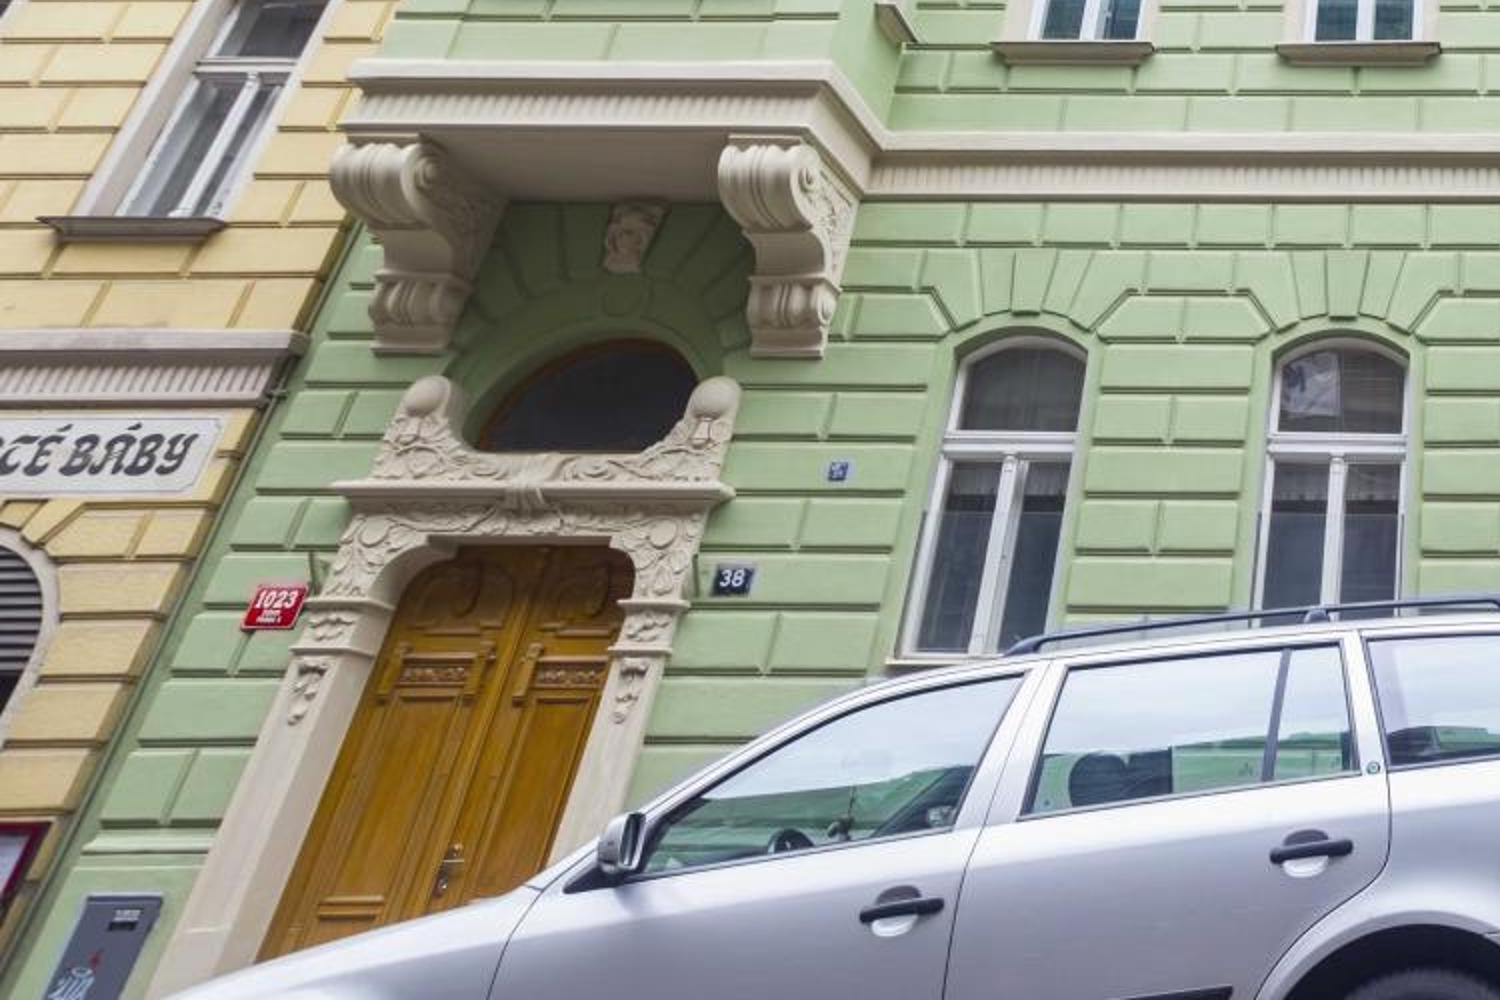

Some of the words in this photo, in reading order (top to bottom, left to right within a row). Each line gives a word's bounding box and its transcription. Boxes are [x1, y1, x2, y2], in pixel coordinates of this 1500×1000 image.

[58, 422, 199, 477] BÁBY
[719, 568, 746, 587] 38
[255, 589, 299, 609] 1023
